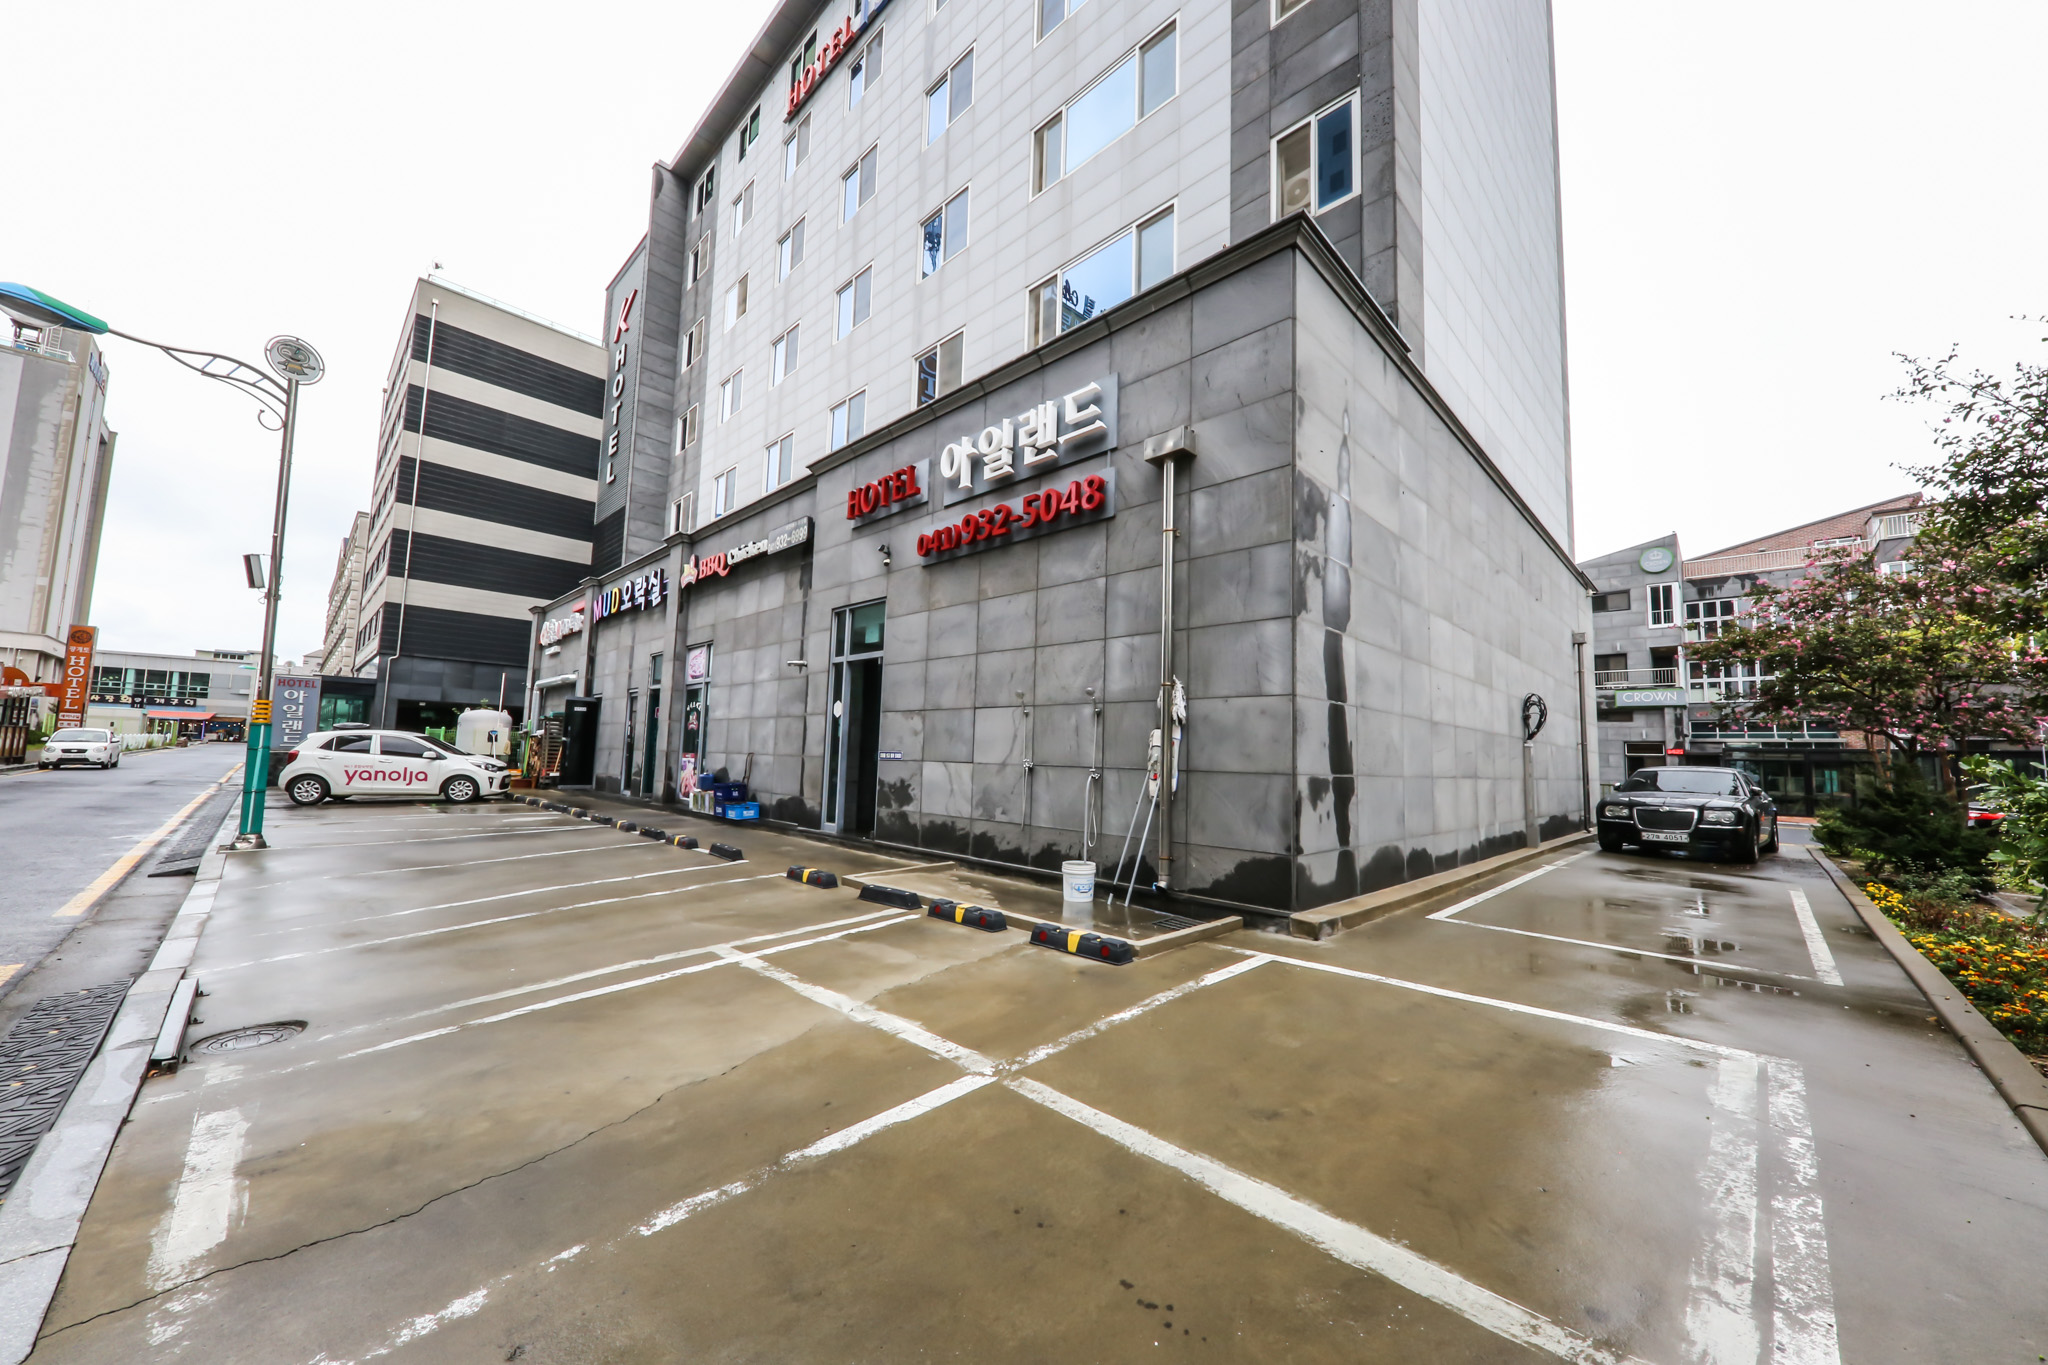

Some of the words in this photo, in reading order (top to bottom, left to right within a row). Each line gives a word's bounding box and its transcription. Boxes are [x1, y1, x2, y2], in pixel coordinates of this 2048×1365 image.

[787, 15, 855, 117] HOTEL
[606, 342, 628, 485] HOTEL
[940, 381, 1108, 490] 아일랜드
[846, 464, 921, 520] HOTEL
[916, 474, 1106, 558] 041)932-5048
[698, 551, 732, 580] BBQ
[593, 587, 620, 624] MUD
[620, 567, 665, 612] 오락실
[63, 655, 87, 710] HOTEL
[277, 678, 317, 689] HOTEL
[1622, 691, 1677, 703] CROWN
[279, 689, 309, 747] 아일랜드
[344, 766, 429, 787] yanolja
